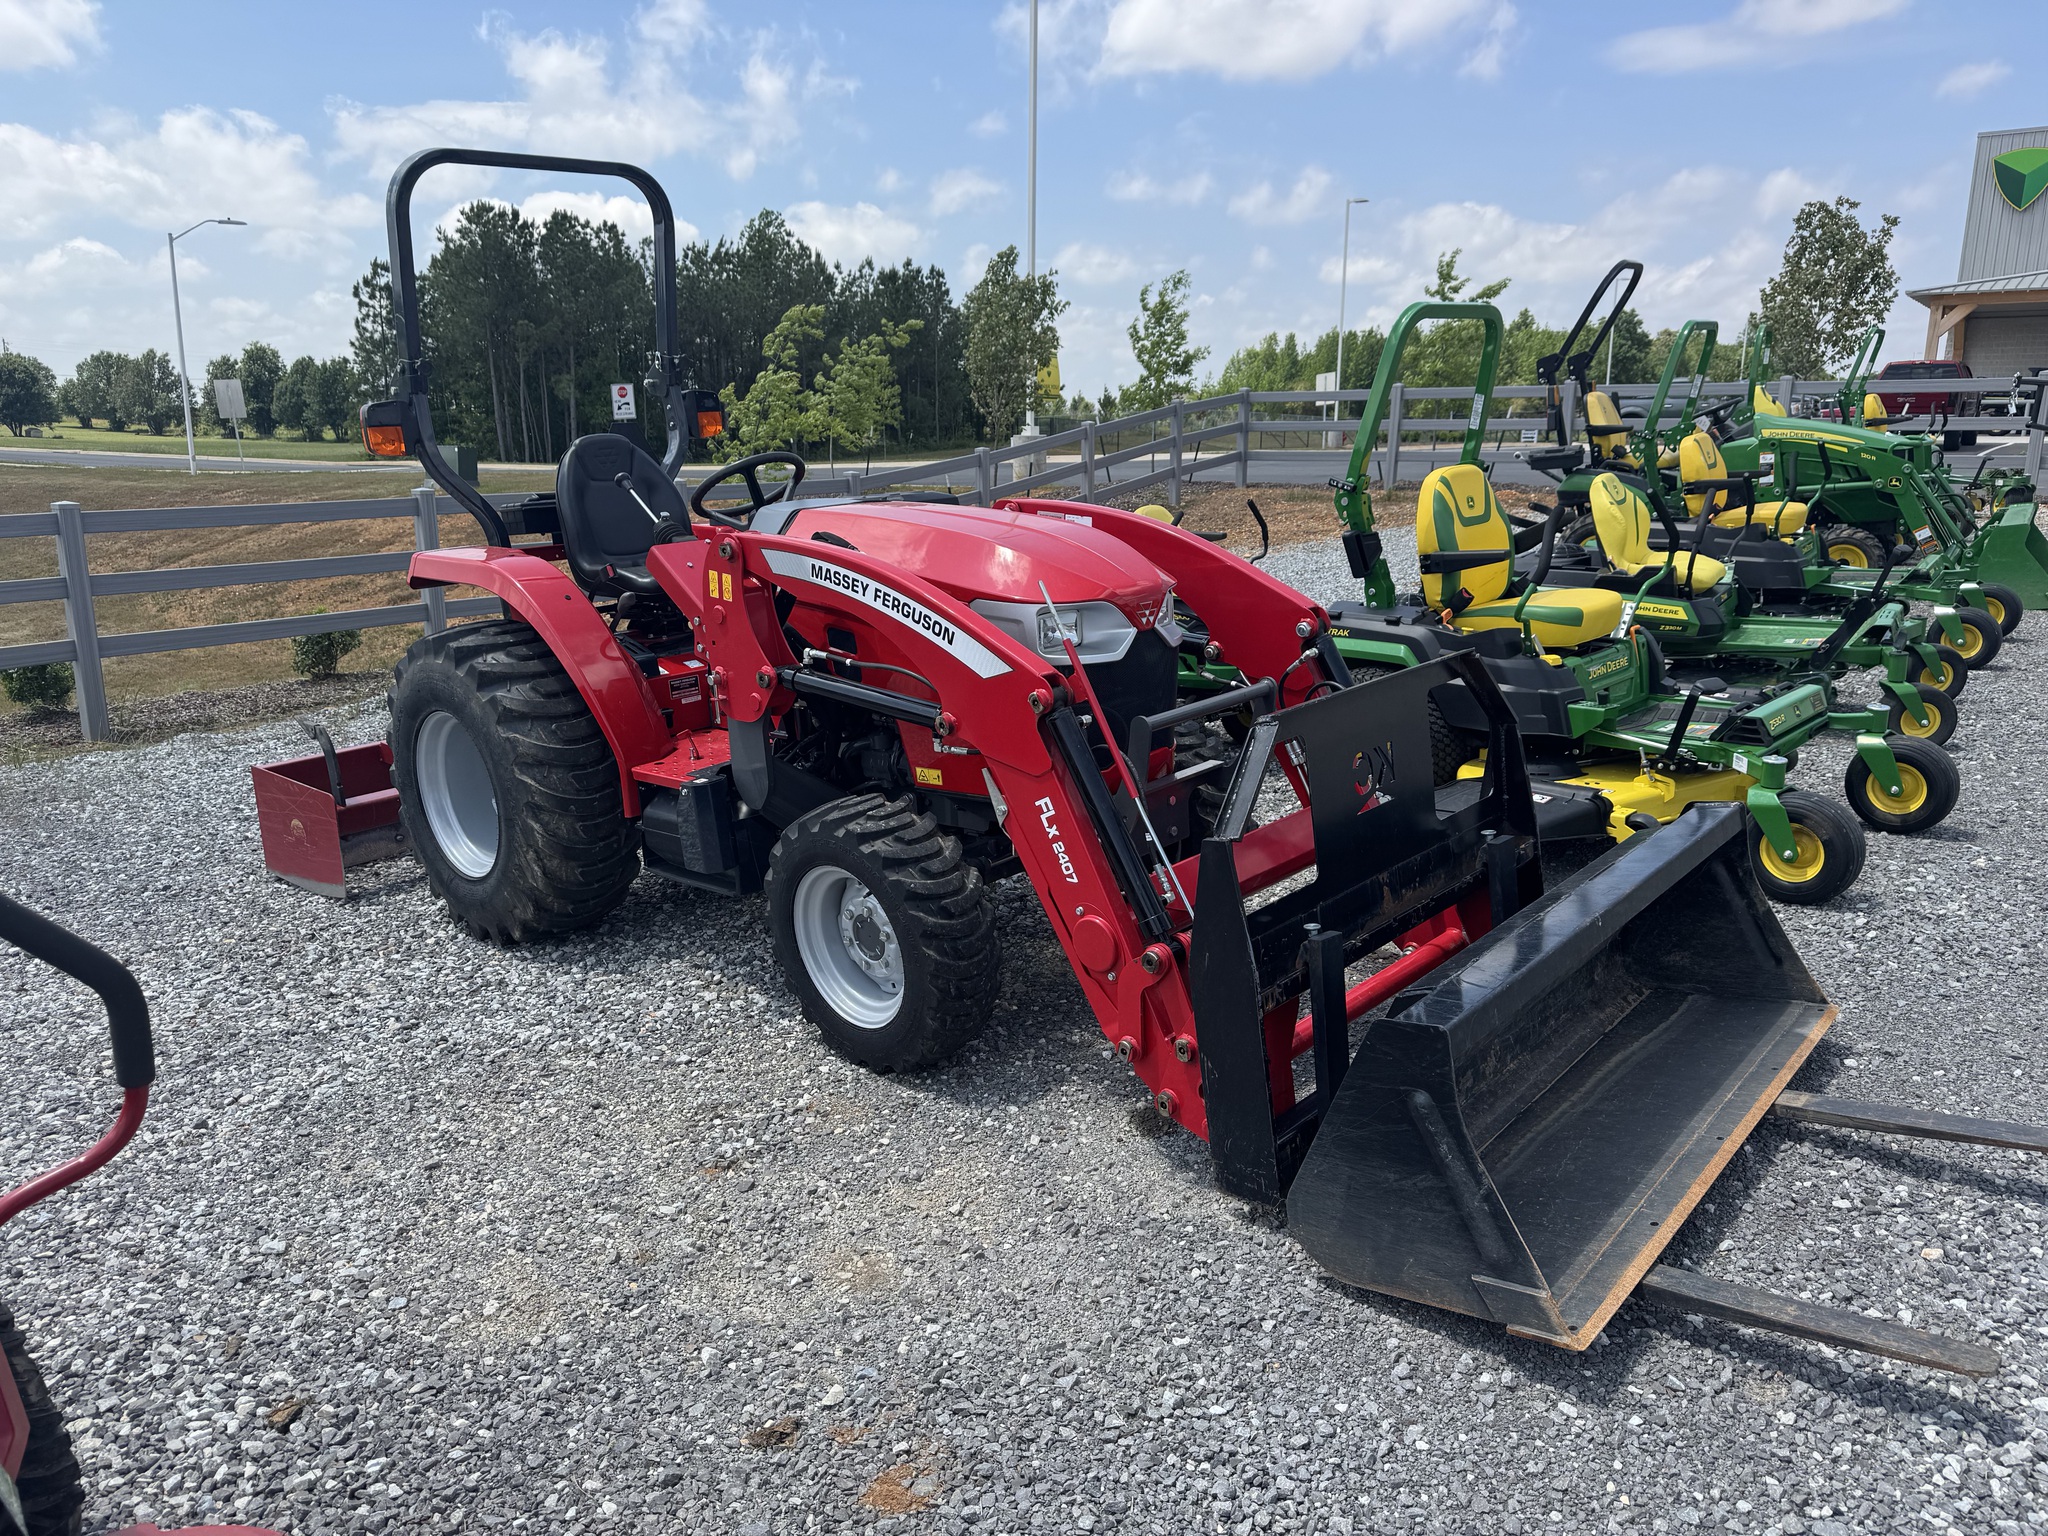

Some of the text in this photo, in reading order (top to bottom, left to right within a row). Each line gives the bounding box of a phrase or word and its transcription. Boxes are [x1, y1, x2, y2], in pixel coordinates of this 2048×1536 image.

[811, 563, 956, 646] MASSEY FERGUSON
[1652, 606, 1680, 615] DEERE
[1325, 627, 1350, 637] TRAK
[1588, 656, 1629, 680] JOHN DEERE
[1034, 796, 1079, 883] FLX 2407
